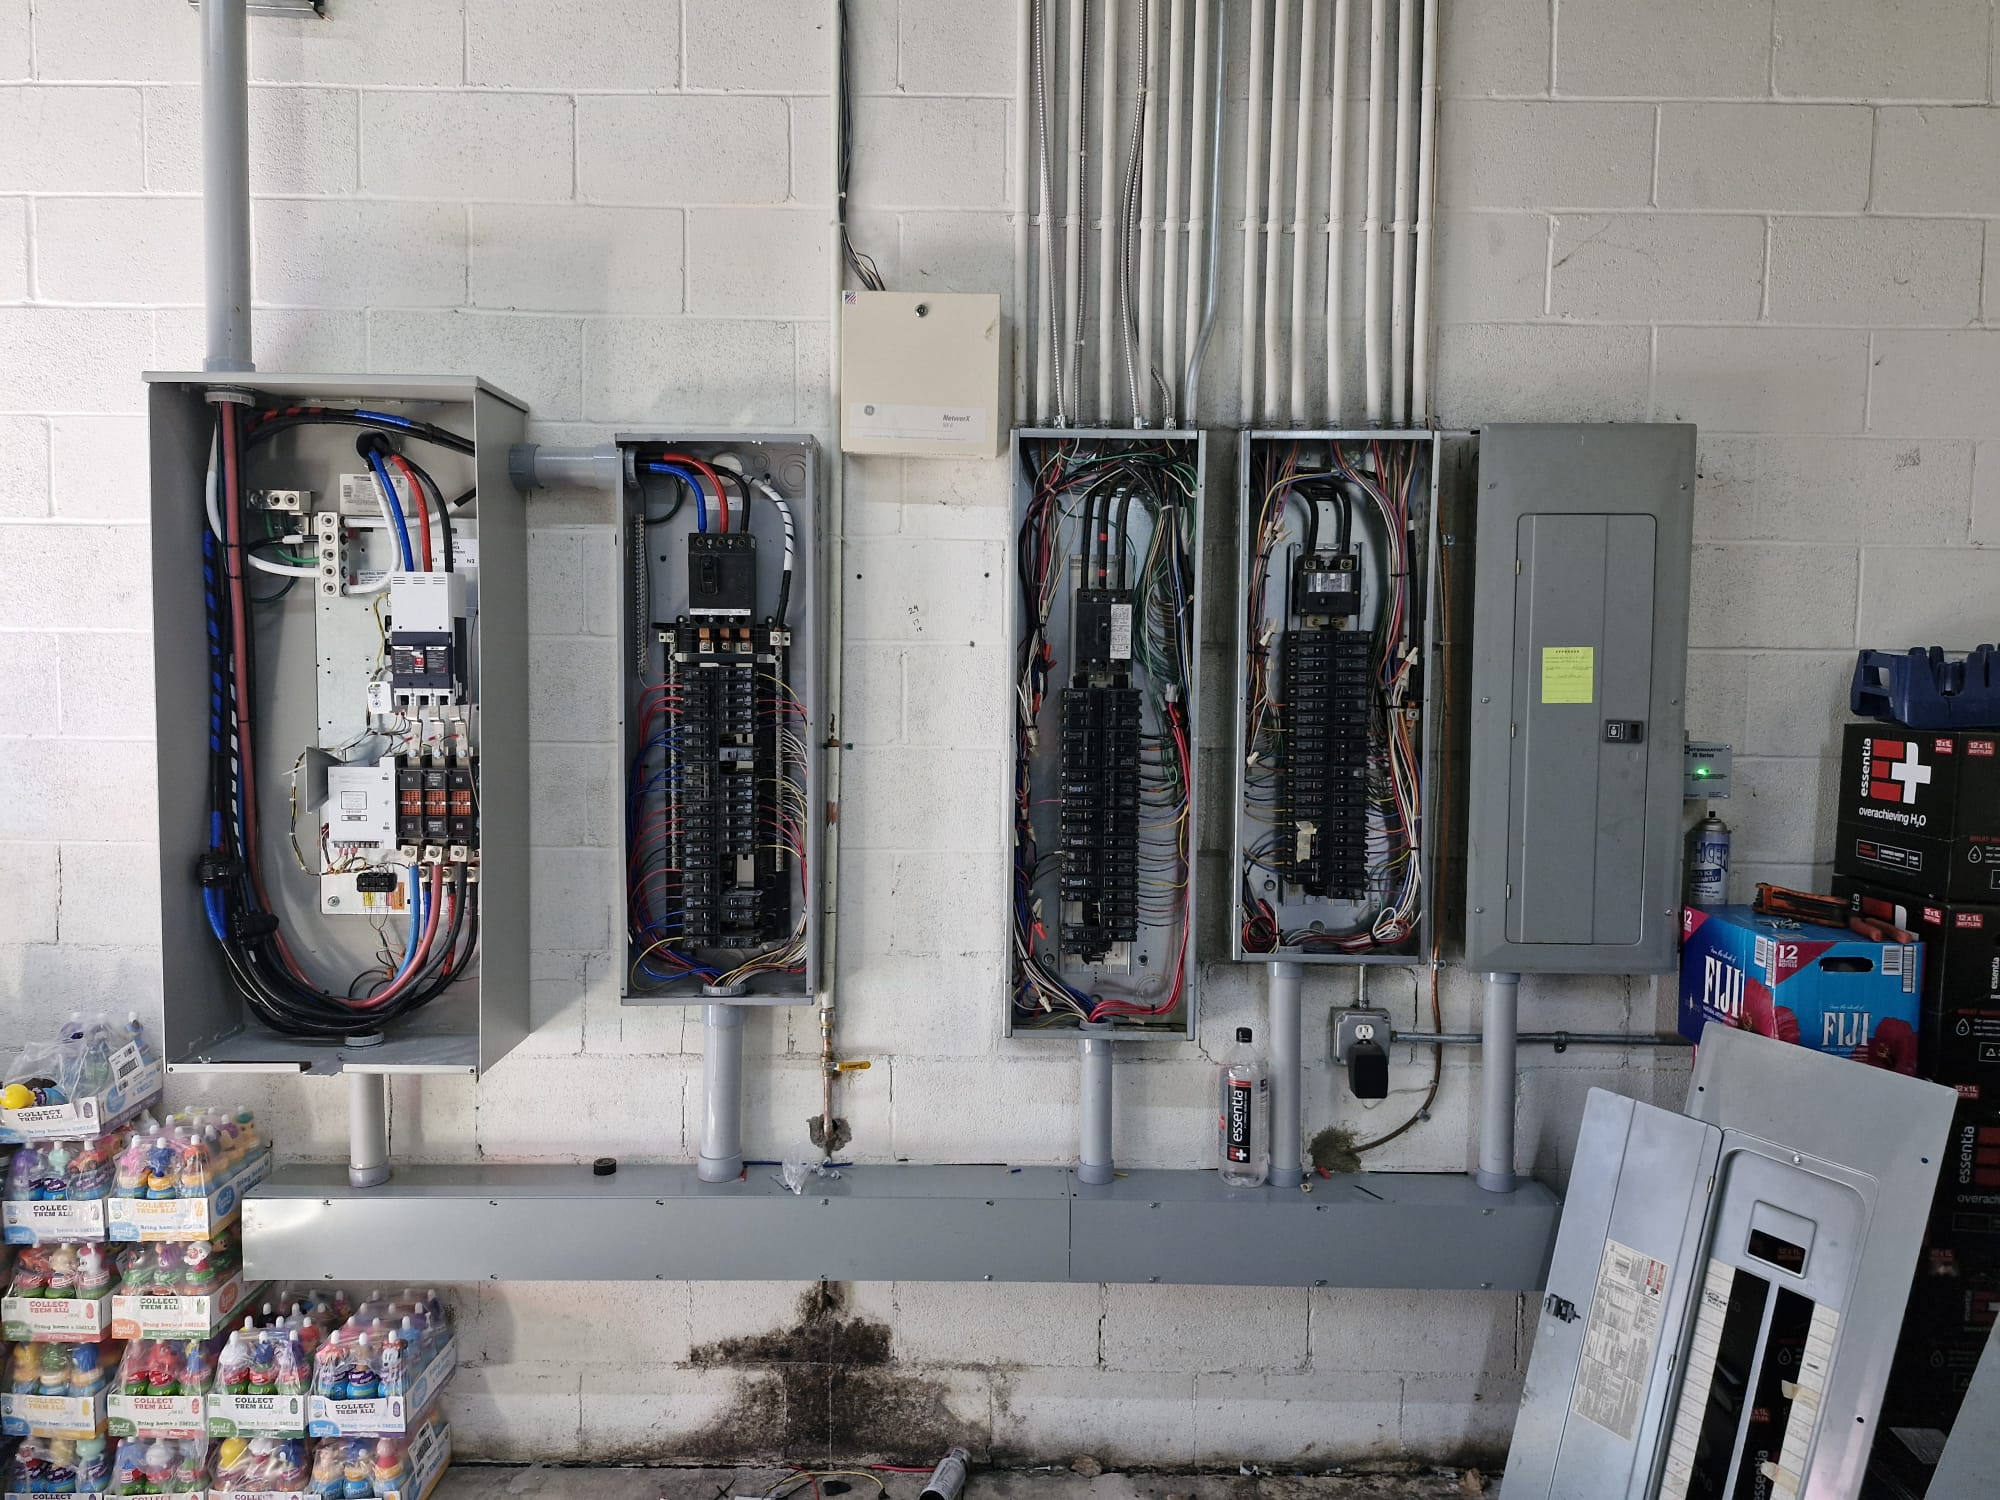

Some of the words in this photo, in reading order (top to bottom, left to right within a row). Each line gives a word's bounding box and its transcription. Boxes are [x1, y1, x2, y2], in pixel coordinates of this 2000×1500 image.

[1861, 738, 1871, 797] essentia
[1859, 807, 1909, 826] overachieving
[1779, 944, 1799, 960] 12
[1703, 955, 1742, 1019] FIJI
[1991, 957, 2000, 990] essentia
[1821, 1012, 1871, 1046] FIJI
[17, 1109, 62, 1118] COLLECT
[1232, 1090, 1244, 1142] essentia
[1959, 1126, 1975, 1185] essentia
[335, 1402, 375, 1410] COLLECT
